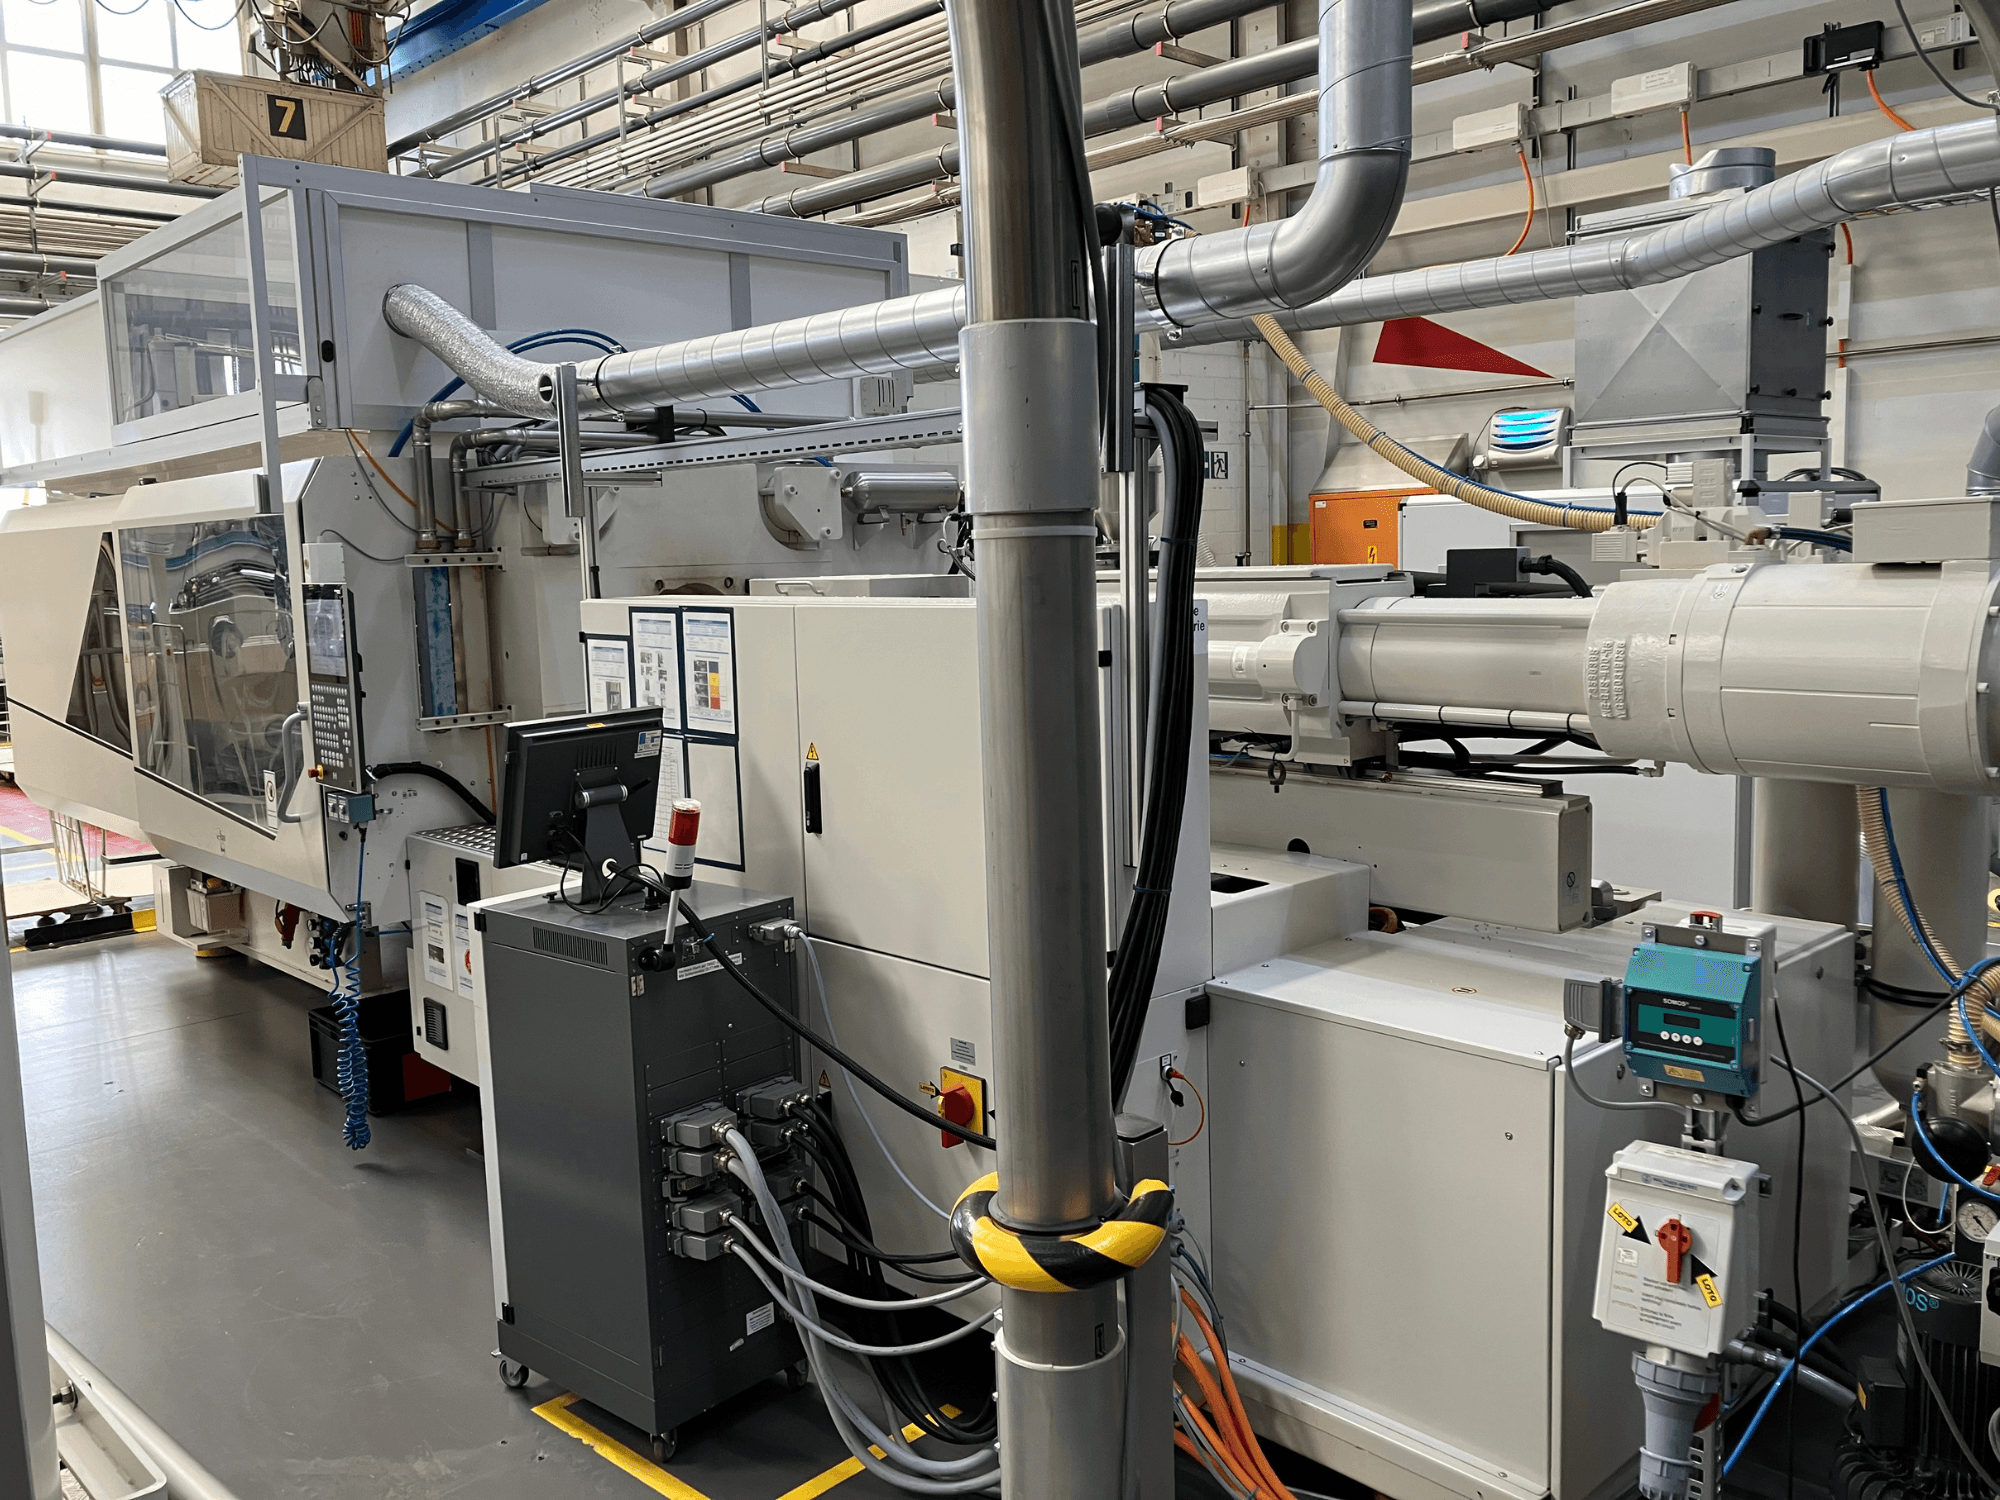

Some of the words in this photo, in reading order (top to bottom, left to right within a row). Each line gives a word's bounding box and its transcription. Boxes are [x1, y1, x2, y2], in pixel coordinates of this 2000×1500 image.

[275, 98, 296, 133] 7
[1193, 620, 1205, 631] rie
[1612, 1207, 1633, 1227] LOTO
[1701, 1278, 1718, 1302] LOTO
